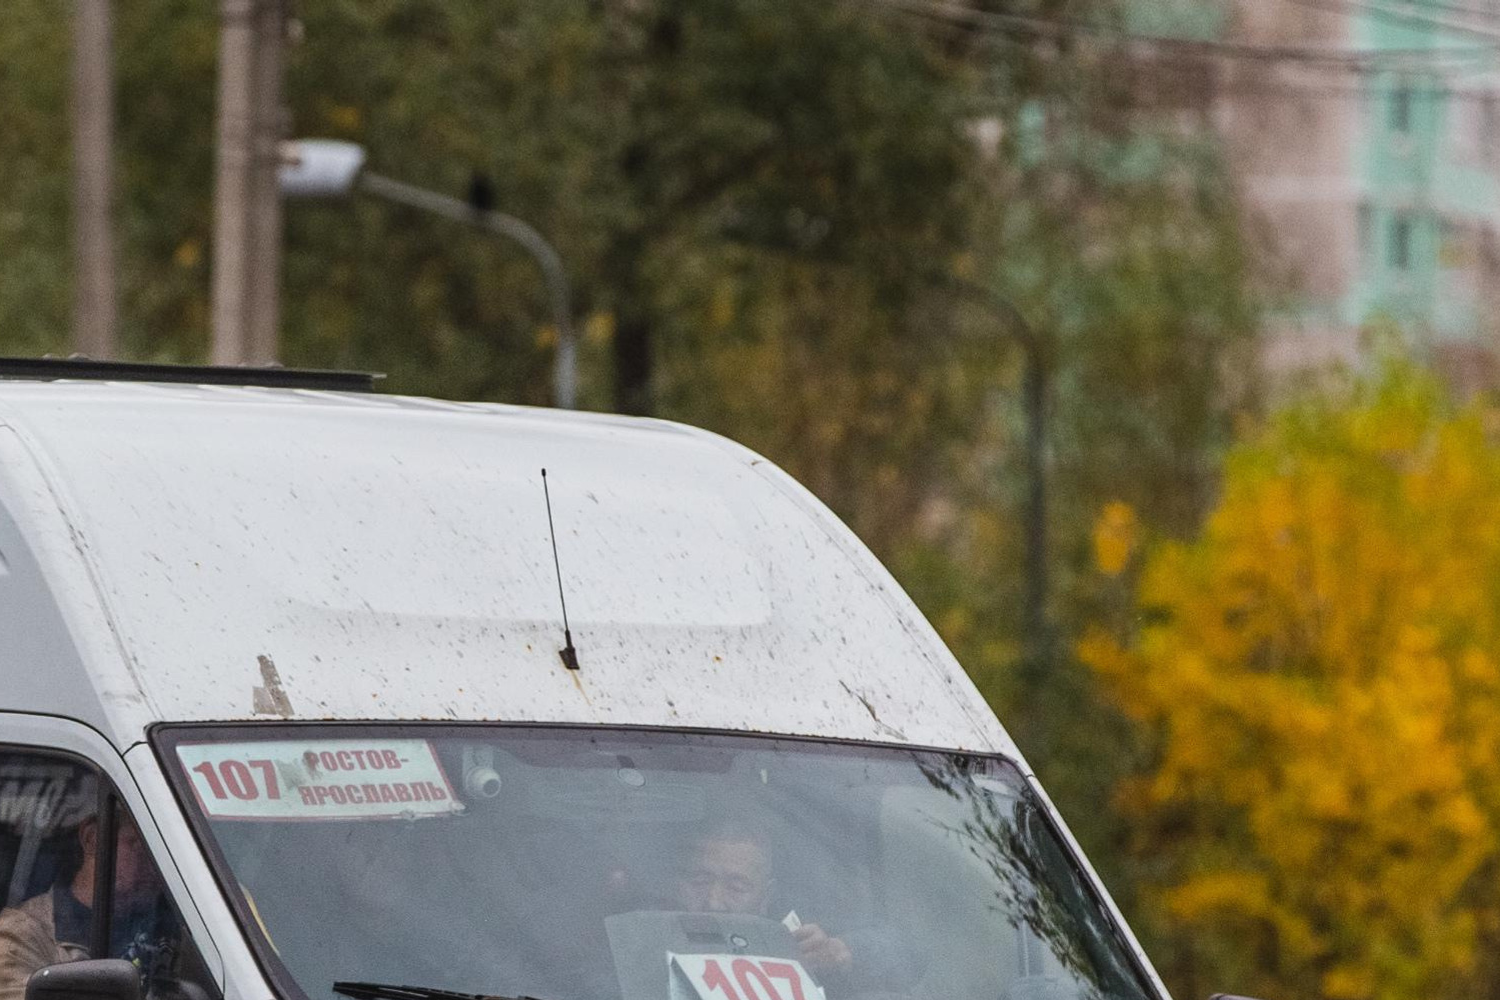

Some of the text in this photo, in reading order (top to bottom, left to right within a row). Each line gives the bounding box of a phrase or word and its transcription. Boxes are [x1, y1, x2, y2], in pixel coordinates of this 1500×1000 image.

[303, 749, 410, 772] РОСТОВ-
[192, 759, 281, 801] 107
[298, 781, 447, 806] ЯРОСЛАВЛЬ
